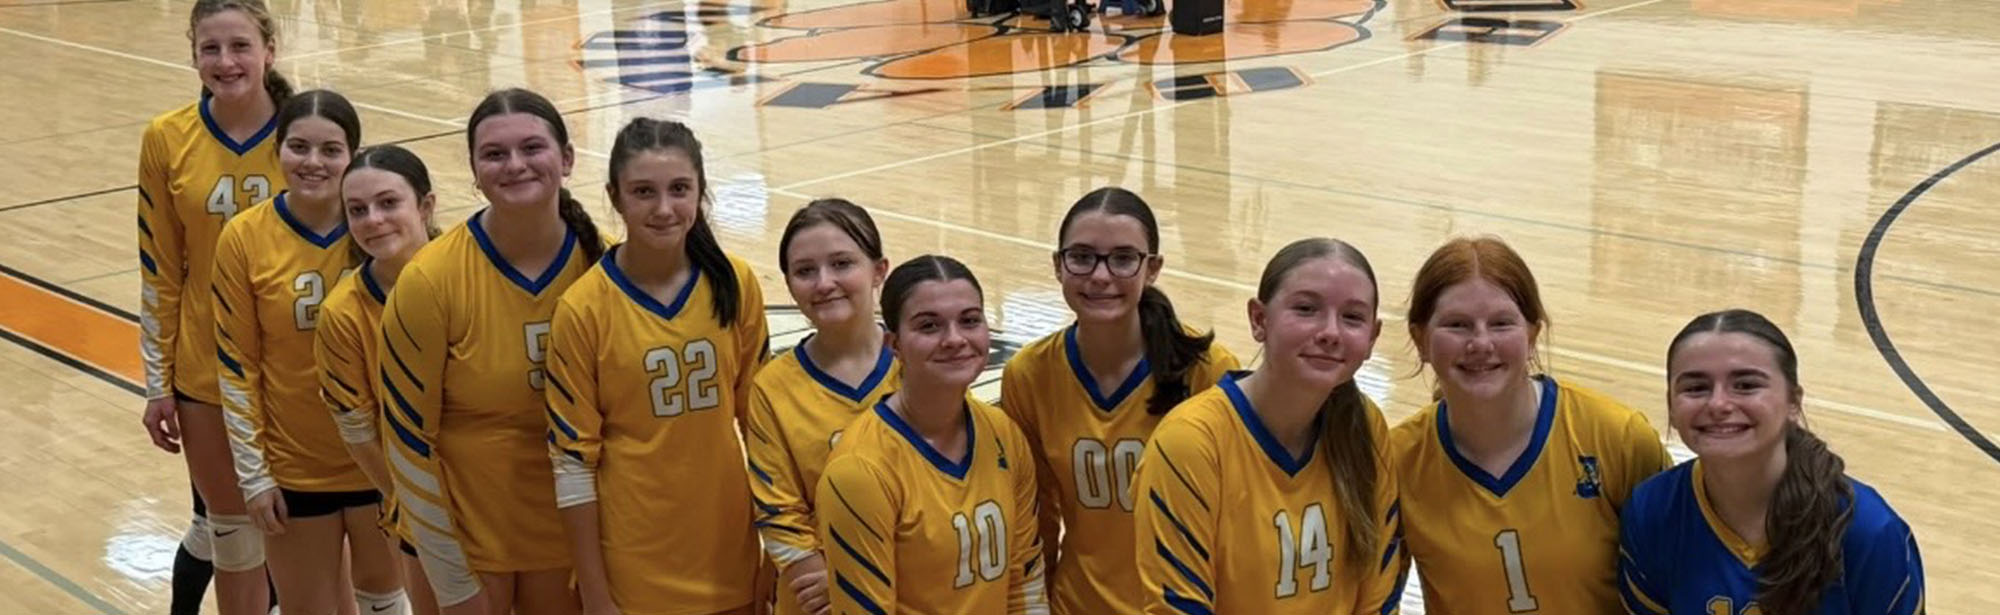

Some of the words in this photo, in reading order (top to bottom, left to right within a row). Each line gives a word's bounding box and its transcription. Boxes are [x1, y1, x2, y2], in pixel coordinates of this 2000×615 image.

[293, 268, 352, 331] 2
[643, 337, 719, 418] 22
[952, 499, 1007, 589] 10
[1273, 502, 1333, 599] 14
[1494, 528, 1539, 614] 1
